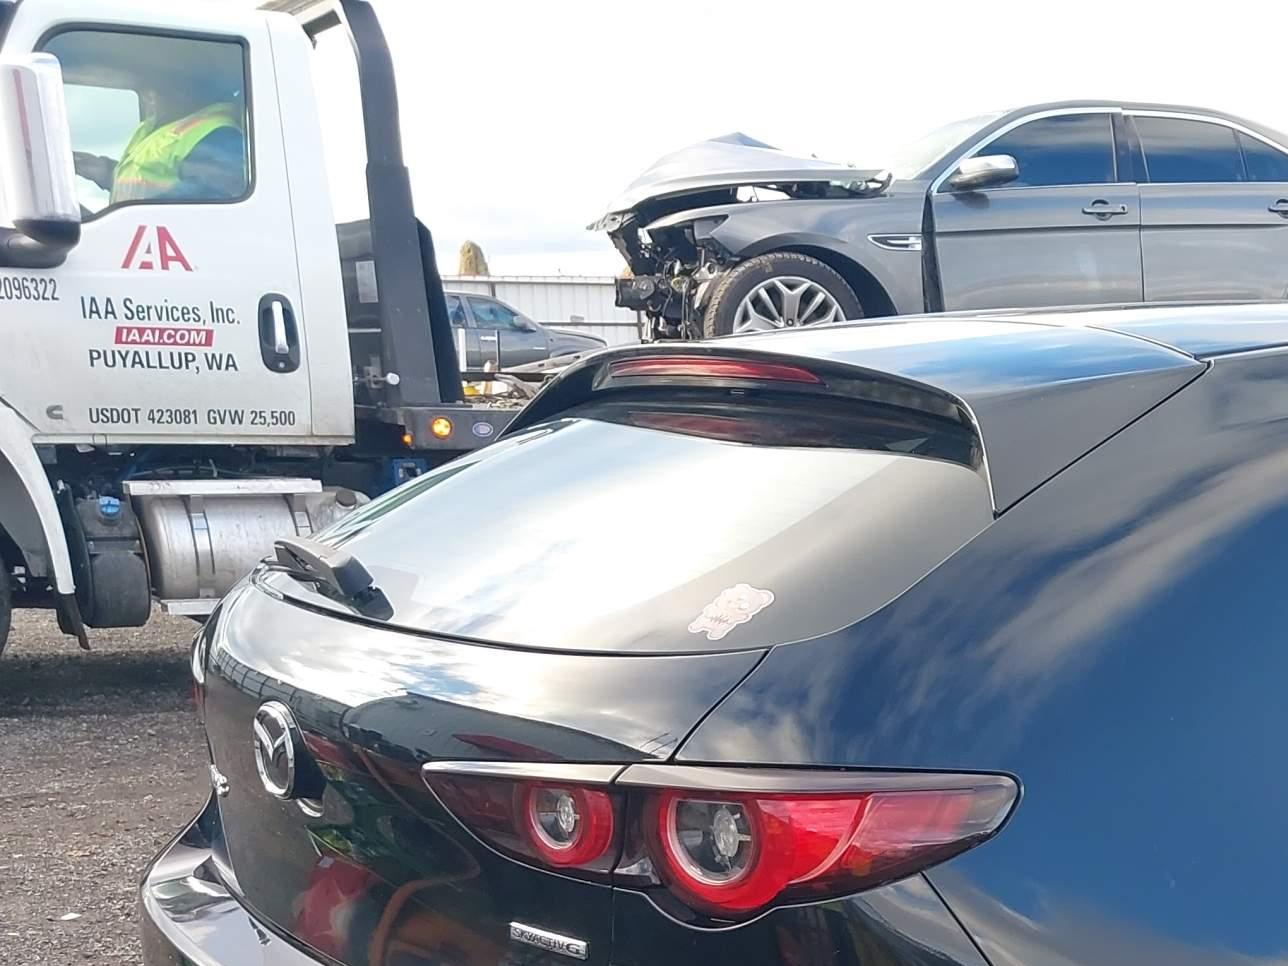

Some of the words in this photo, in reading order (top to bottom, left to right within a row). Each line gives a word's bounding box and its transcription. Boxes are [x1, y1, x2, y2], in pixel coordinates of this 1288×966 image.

[80, 296, 118, 320] IAA
[123, 297, 206, 326] Services,
[210, 300, 241, 325] Inc.
[121, 328, 207, 345] IAAI.COM
[88, 349, 200, 374] PUYALLUP,
[204, 352, 239, 372] WA
[89, 407, 141, 424] USDOT
[147, 408, 198, 425] 423081
[207, 409, 245, 426] GVW
[250, 410, 296, 428] 25,500
